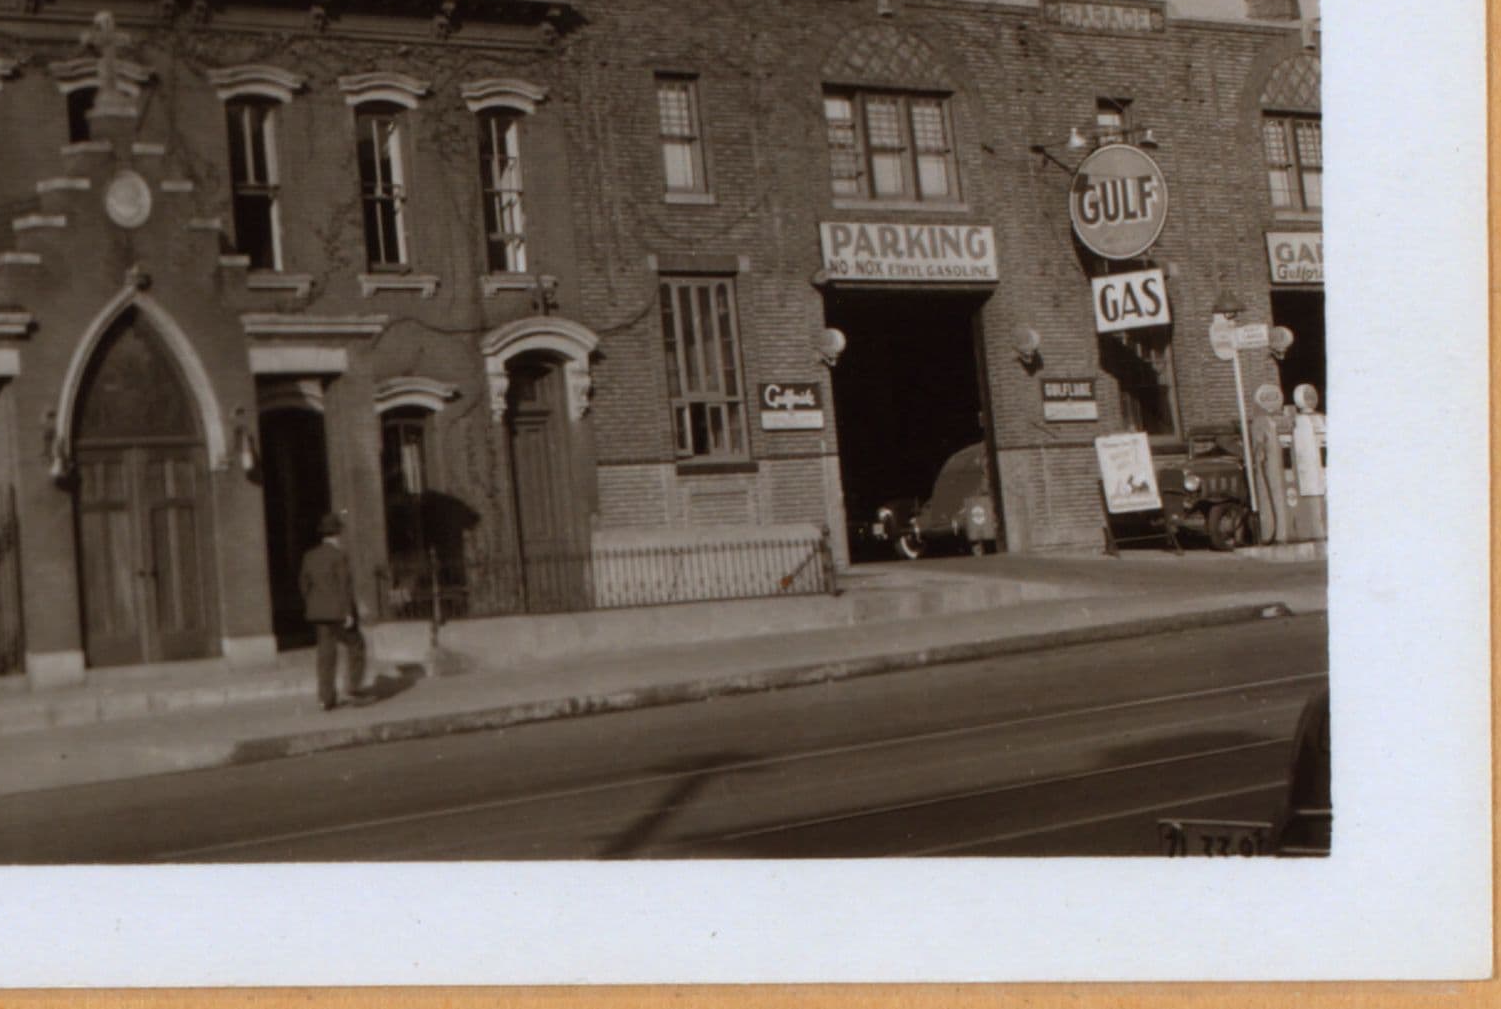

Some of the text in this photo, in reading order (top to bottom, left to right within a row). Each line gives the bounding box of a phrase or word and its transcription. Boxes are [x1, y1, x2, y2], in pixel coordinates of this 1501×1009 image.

[1077, 175, 1156, 226] GULF
[829, 224, 987, 260] PARKING
[927, 265, 991, 279] GASOLINE
[1101, 278, 1161, 322] GAS
